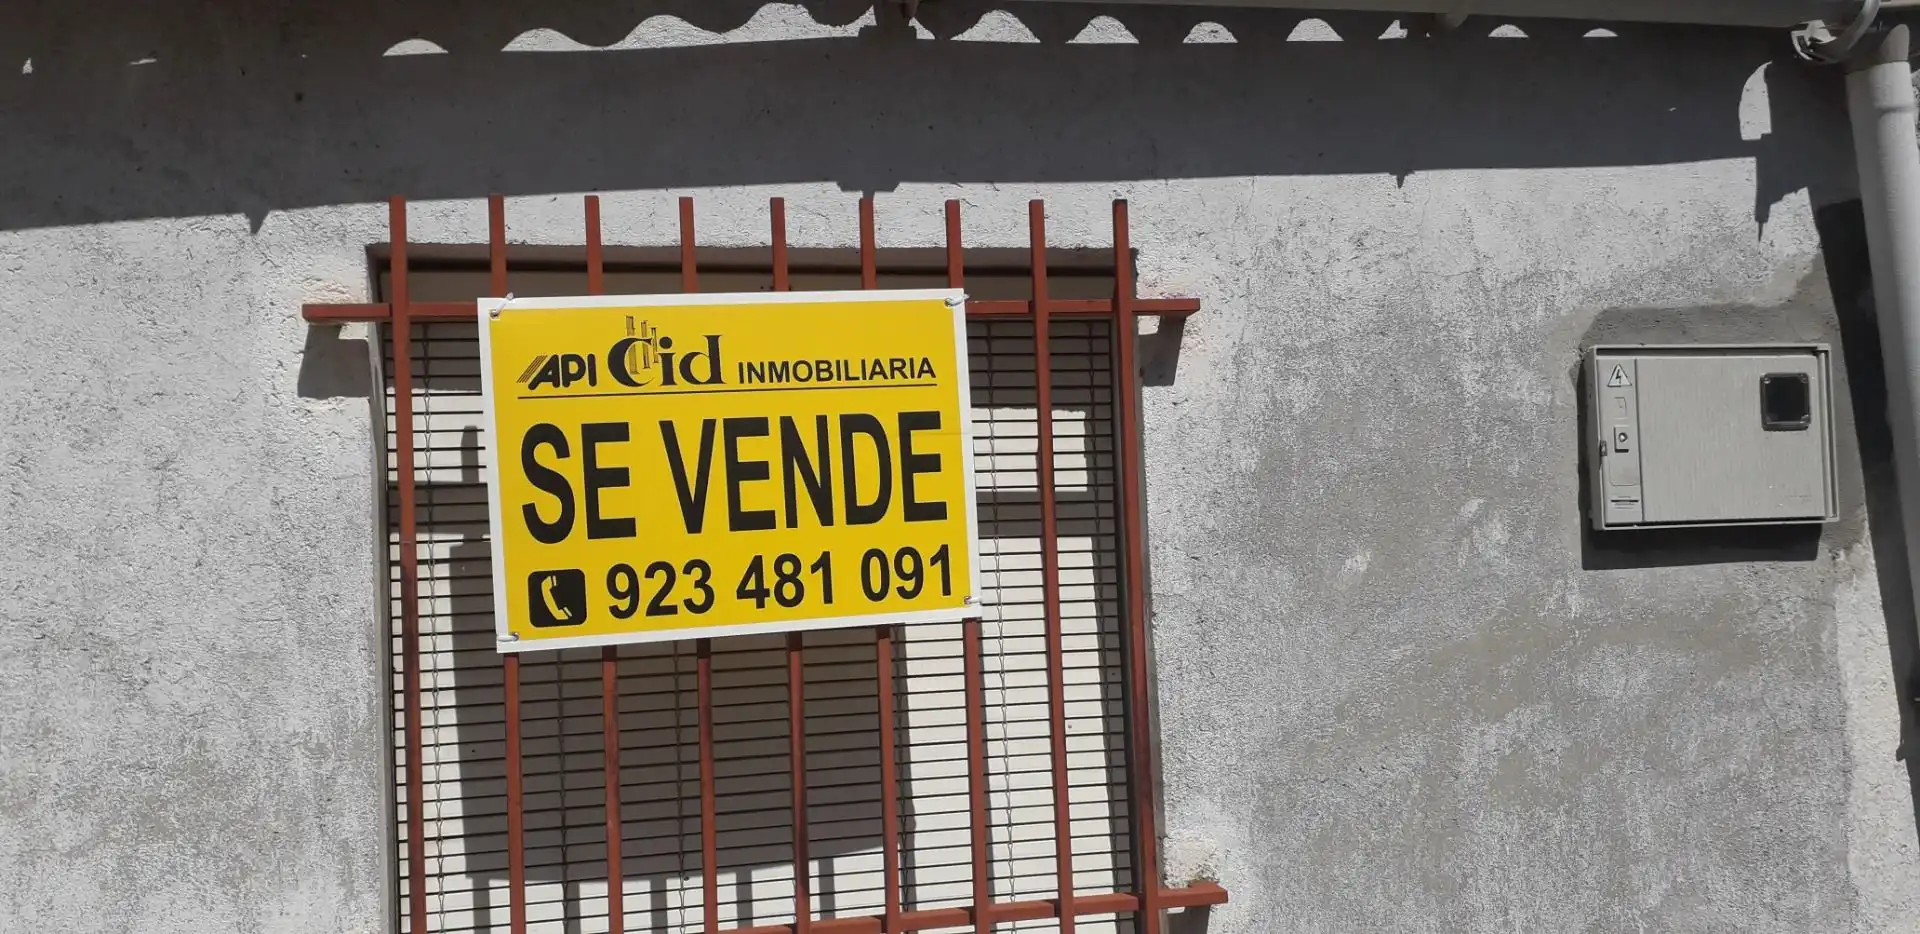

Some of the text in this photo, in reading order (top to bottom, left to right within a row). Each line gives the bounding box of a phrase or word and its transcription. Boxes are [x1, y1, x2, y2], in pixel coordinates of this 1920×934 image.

[522, 334, 936, 391] API Cid INMOBILIARIA
[520, 411, 948, 544] SE VENDE
[606, 544, 952, 619] 923 481 091
